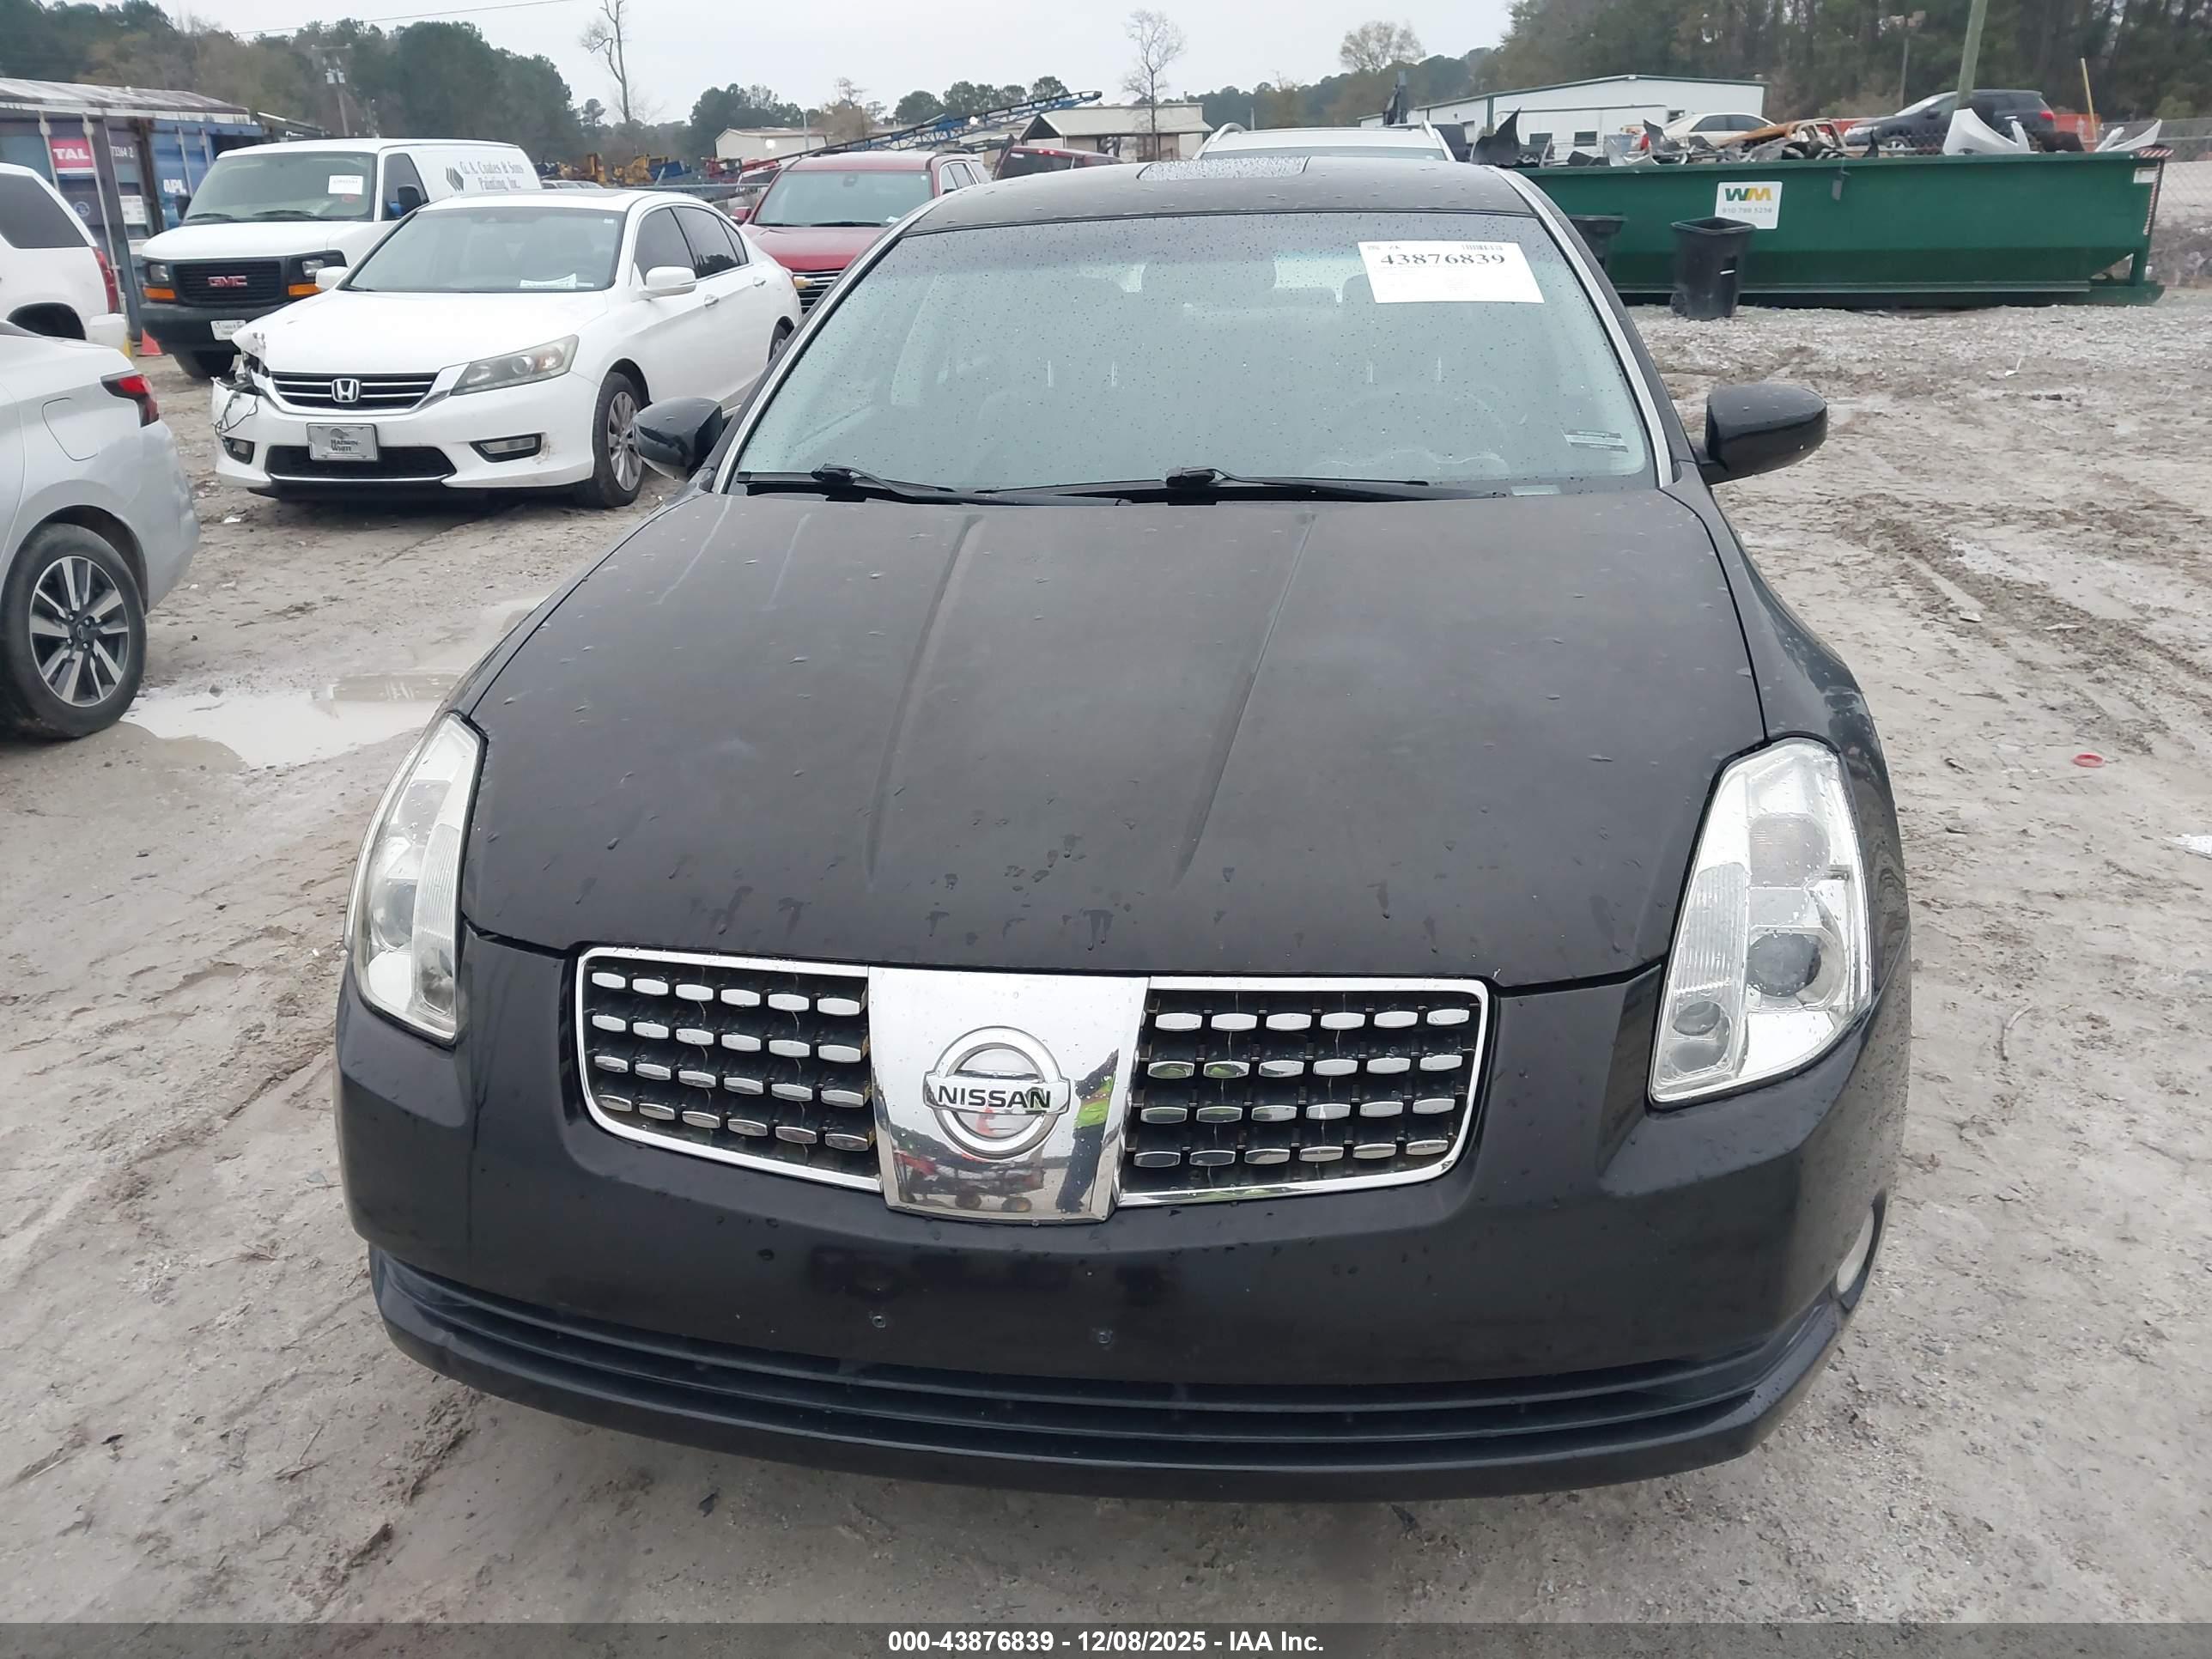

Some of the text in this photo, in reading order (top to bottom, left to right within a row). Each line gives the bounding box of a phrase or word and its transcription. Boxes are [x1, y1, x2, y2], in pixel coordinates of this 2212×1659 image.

[52, 148, 89, 161] TAL
[163, 179, 186, 193] APL
[1724, 187, 1772, 201] WM
[1380, 253, 1505, 265] 43876839
[208, 276, 247, 288] GMC
[939, 1085, 1051, 1109] NISSAN
